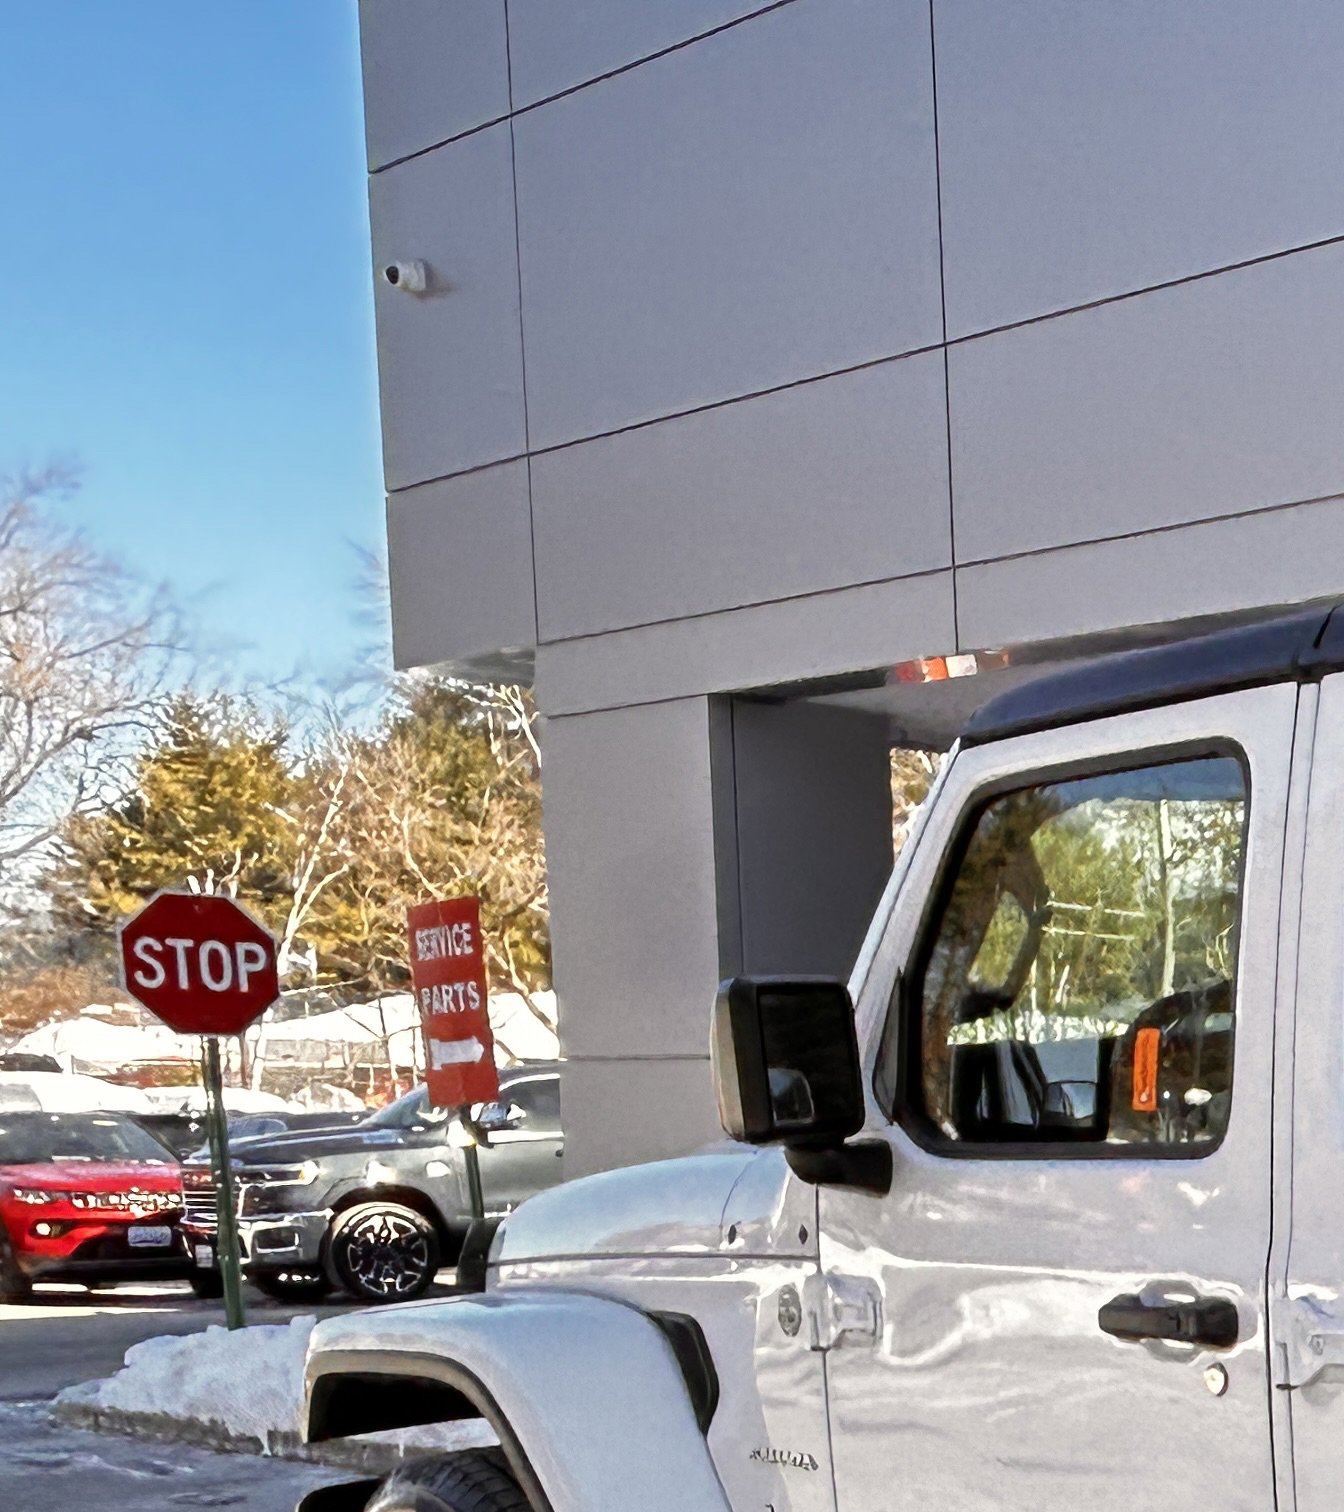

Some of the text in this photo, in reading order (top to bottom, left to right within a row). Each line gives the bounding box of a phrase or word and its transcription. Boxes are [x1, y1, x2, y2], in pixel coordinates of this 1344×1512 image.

[415, 922, 474, 961] SERVICE
[133, 936, 267, 993] STOP
[421, 980, 480, 1016] PARTS
